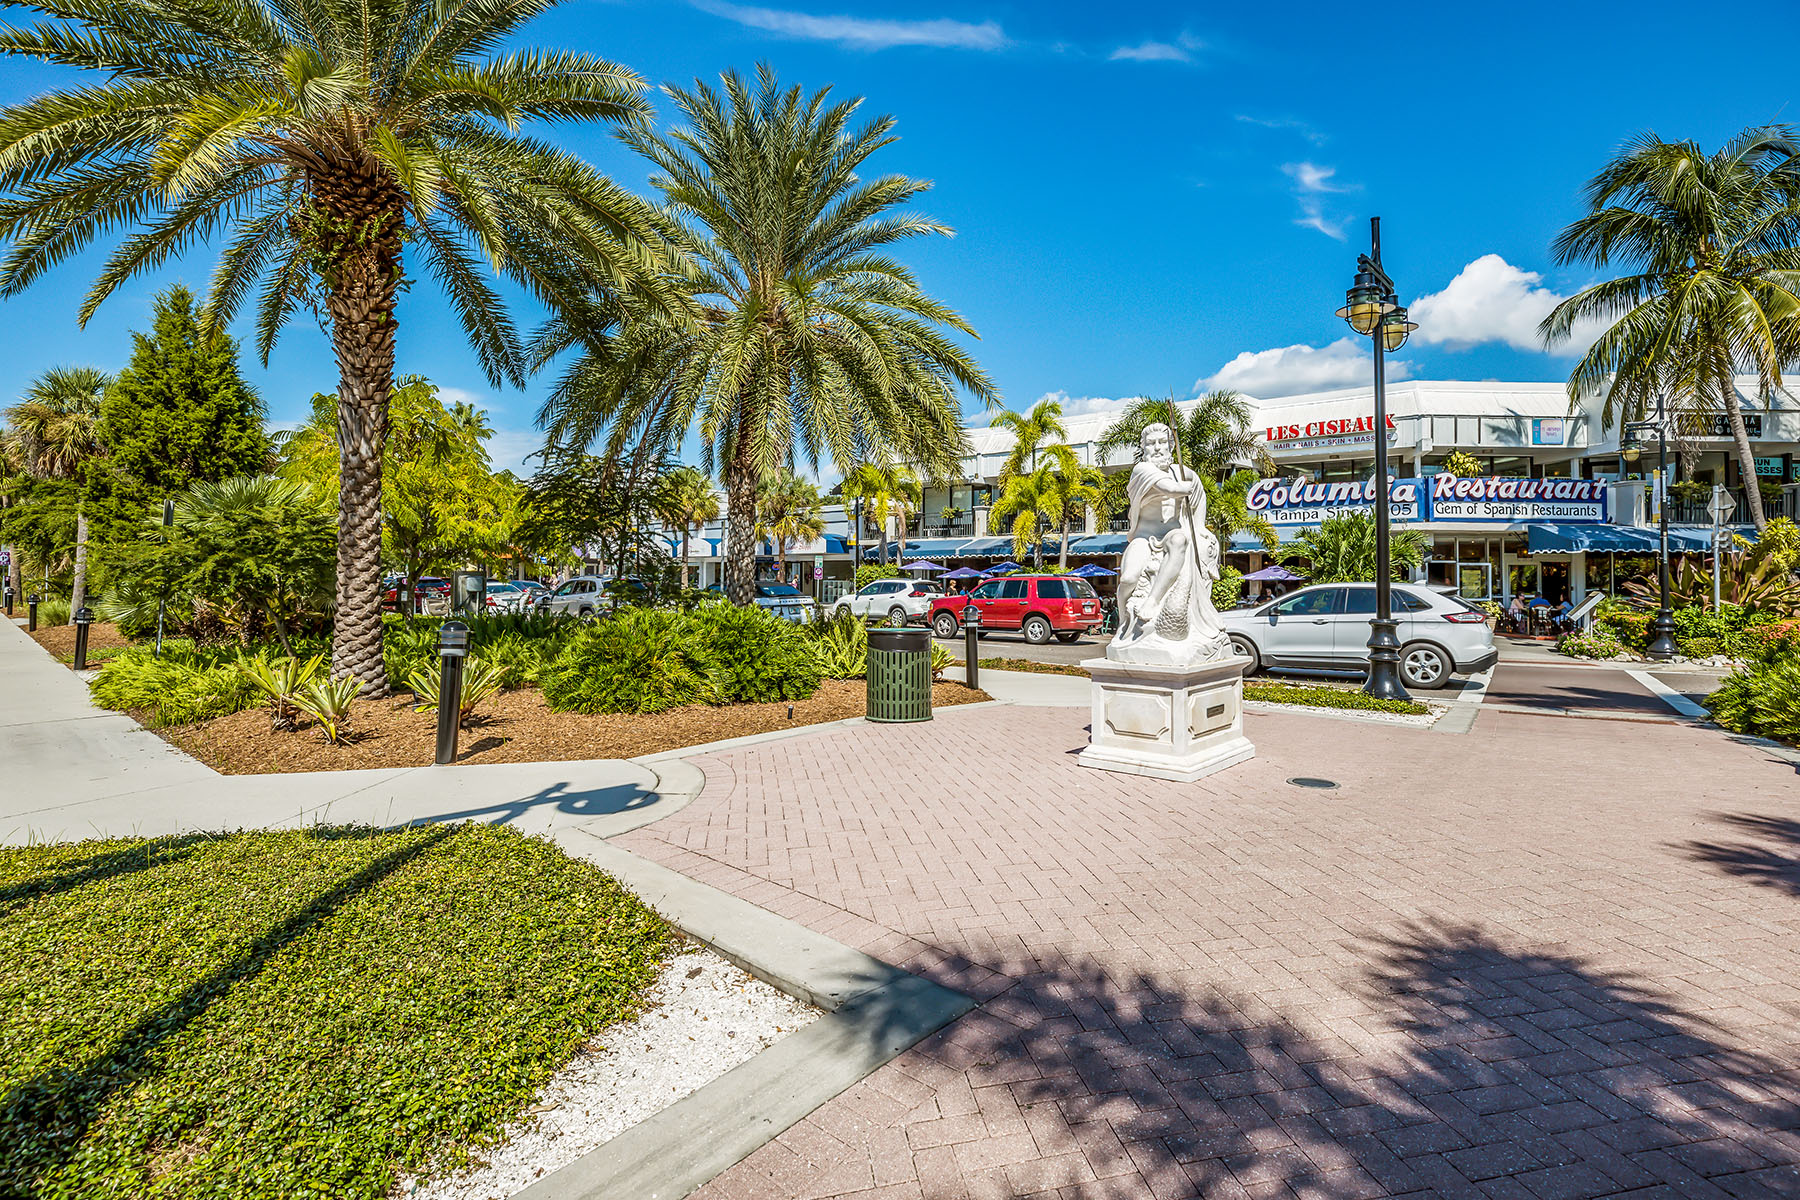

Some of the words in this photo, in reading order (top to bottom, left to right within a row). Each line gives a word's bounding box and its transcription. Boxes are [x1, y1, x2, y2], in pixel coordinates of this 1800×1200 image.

[1266, 424, 1300, 441] LES
[1298, 439, 1320, 449] NAILS
[1327, 438, 1346, 446] SKIN
[1353, 433, 1392, 442] MASSE
[1433, 472, 1607, 500] Restaurant
[1271, 508, 1319, 522] Tampa
[1435, 502, 1462, 515] Gem
[1466, 501, 1478, 515] of
[1483, 502, 1528, 518] Spanish
[1532, 504, 1597, 517] Restaurants
